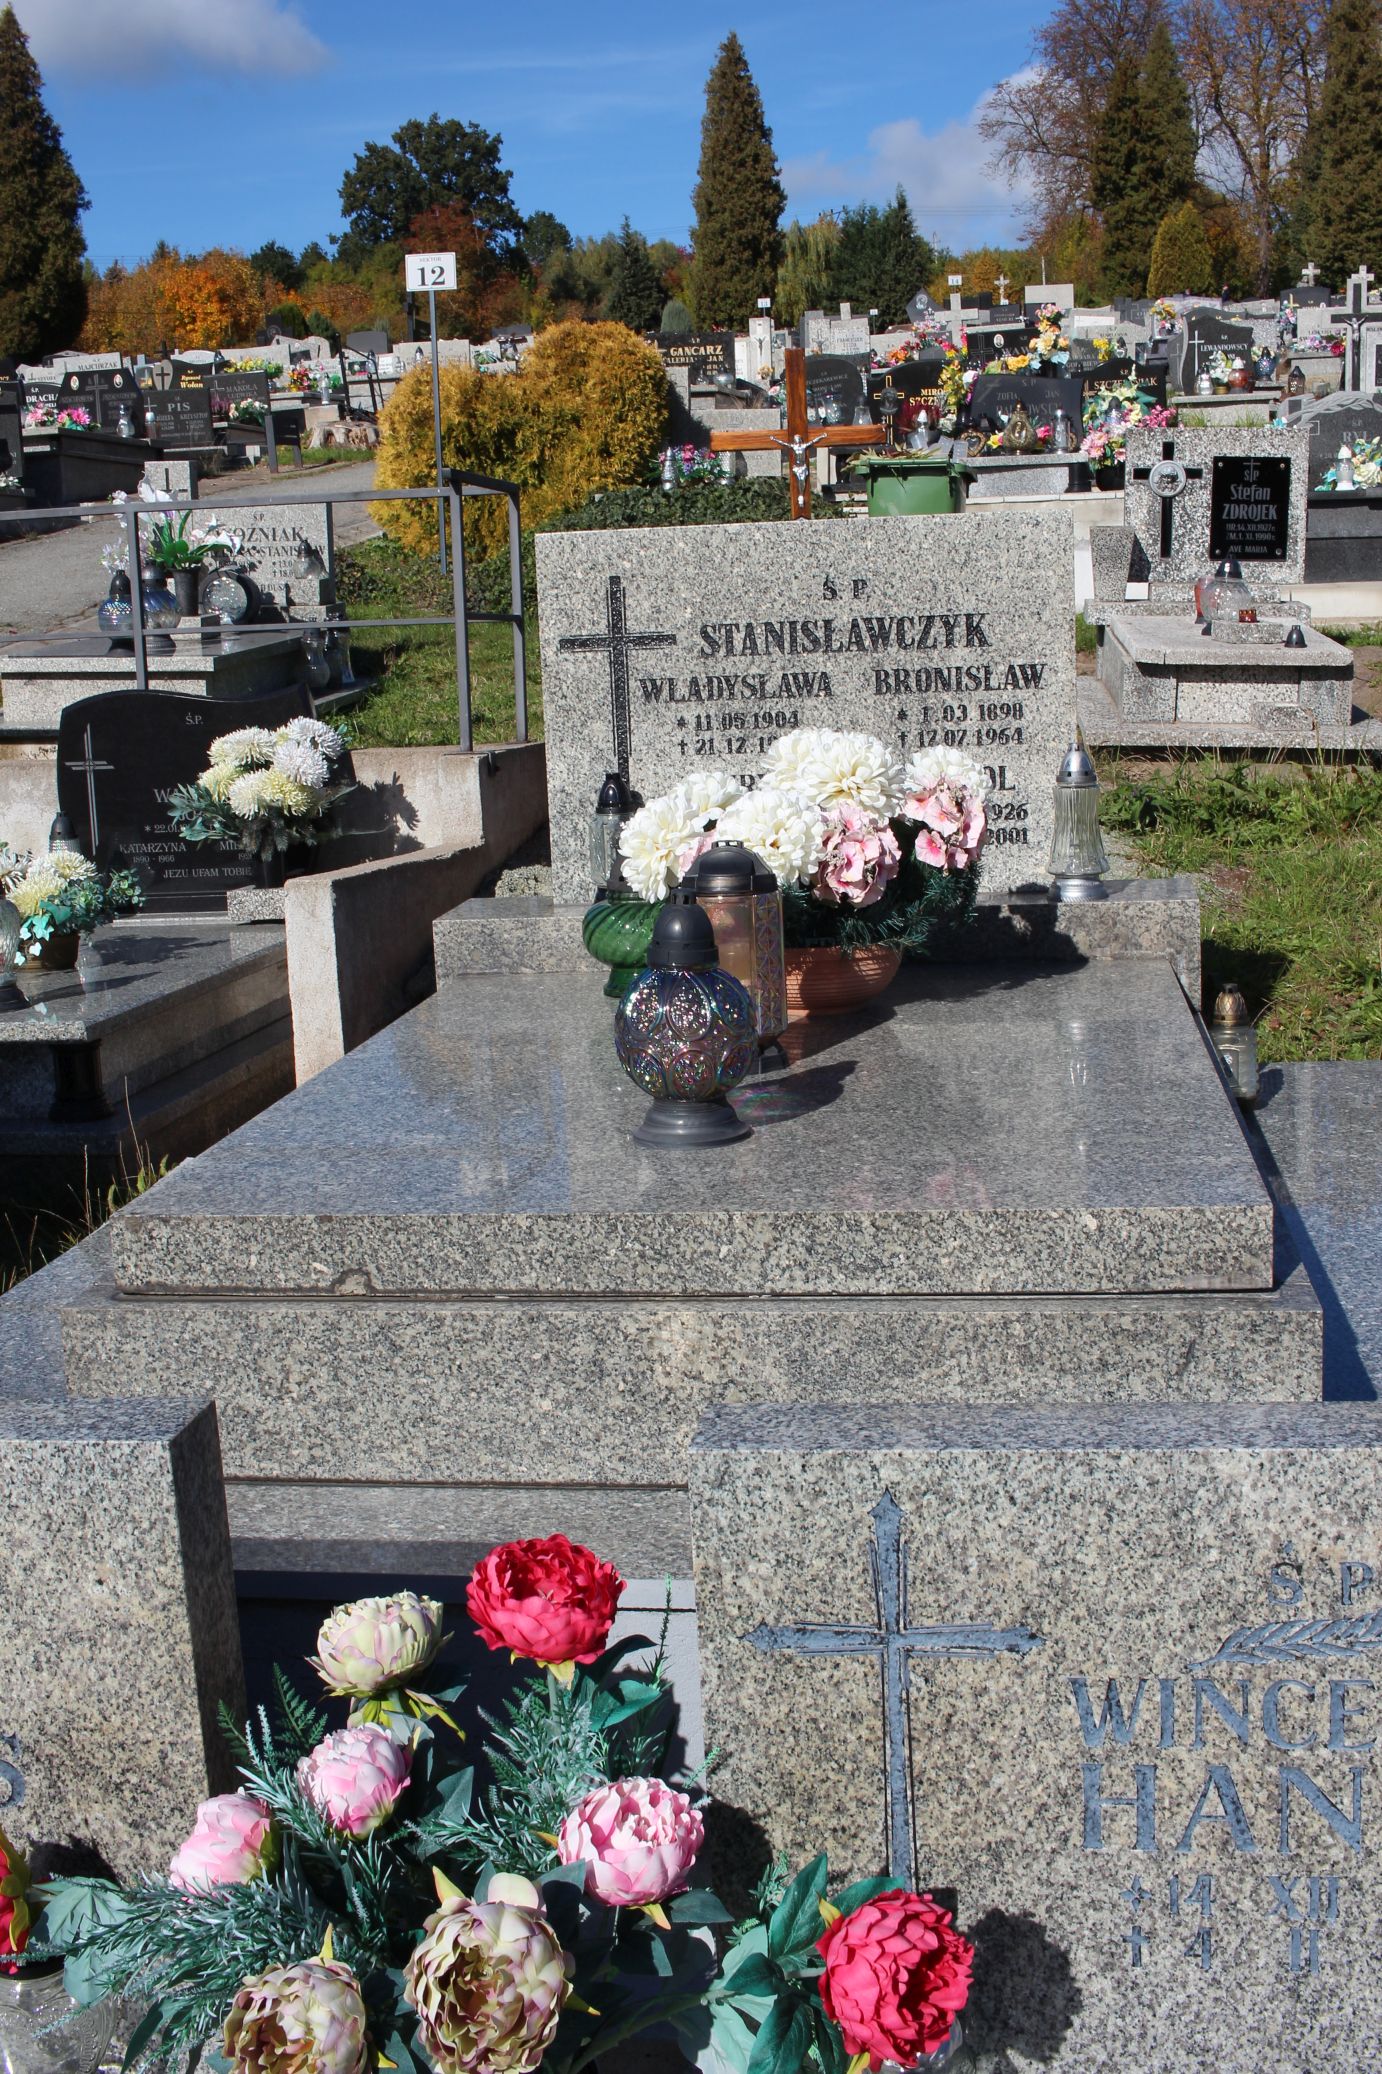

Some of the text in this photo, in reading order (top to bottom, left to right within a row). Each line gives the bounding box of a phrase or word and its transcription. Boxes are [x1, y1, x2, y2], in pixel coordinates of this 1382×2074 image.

[417, 265, 446, 287] 12
[670, 344, 724, 357] GANCARZ
[167, 402, 191, 412] PIS
[1230, 484, 1271, 502] Stefan
[1222, 503, 1278, 522] ZDROJEK
[1229, 545, 1242, 553] AVE
[699, 611, 993, 658] STANISŁAWCZYK
[640, 661, 1048, 703] WŁADYSŁAWA BRONISŁAW
[120, 842, 187, 854] KATARZYNA
[163, 866, 252, 878] JEZU UFAM TOBIE
[1069, 1677, 1377, 1751] WINCE
[1082, 1763, 1366, 1854] HAN
[1167, 1873, 1214, 1918] 14
